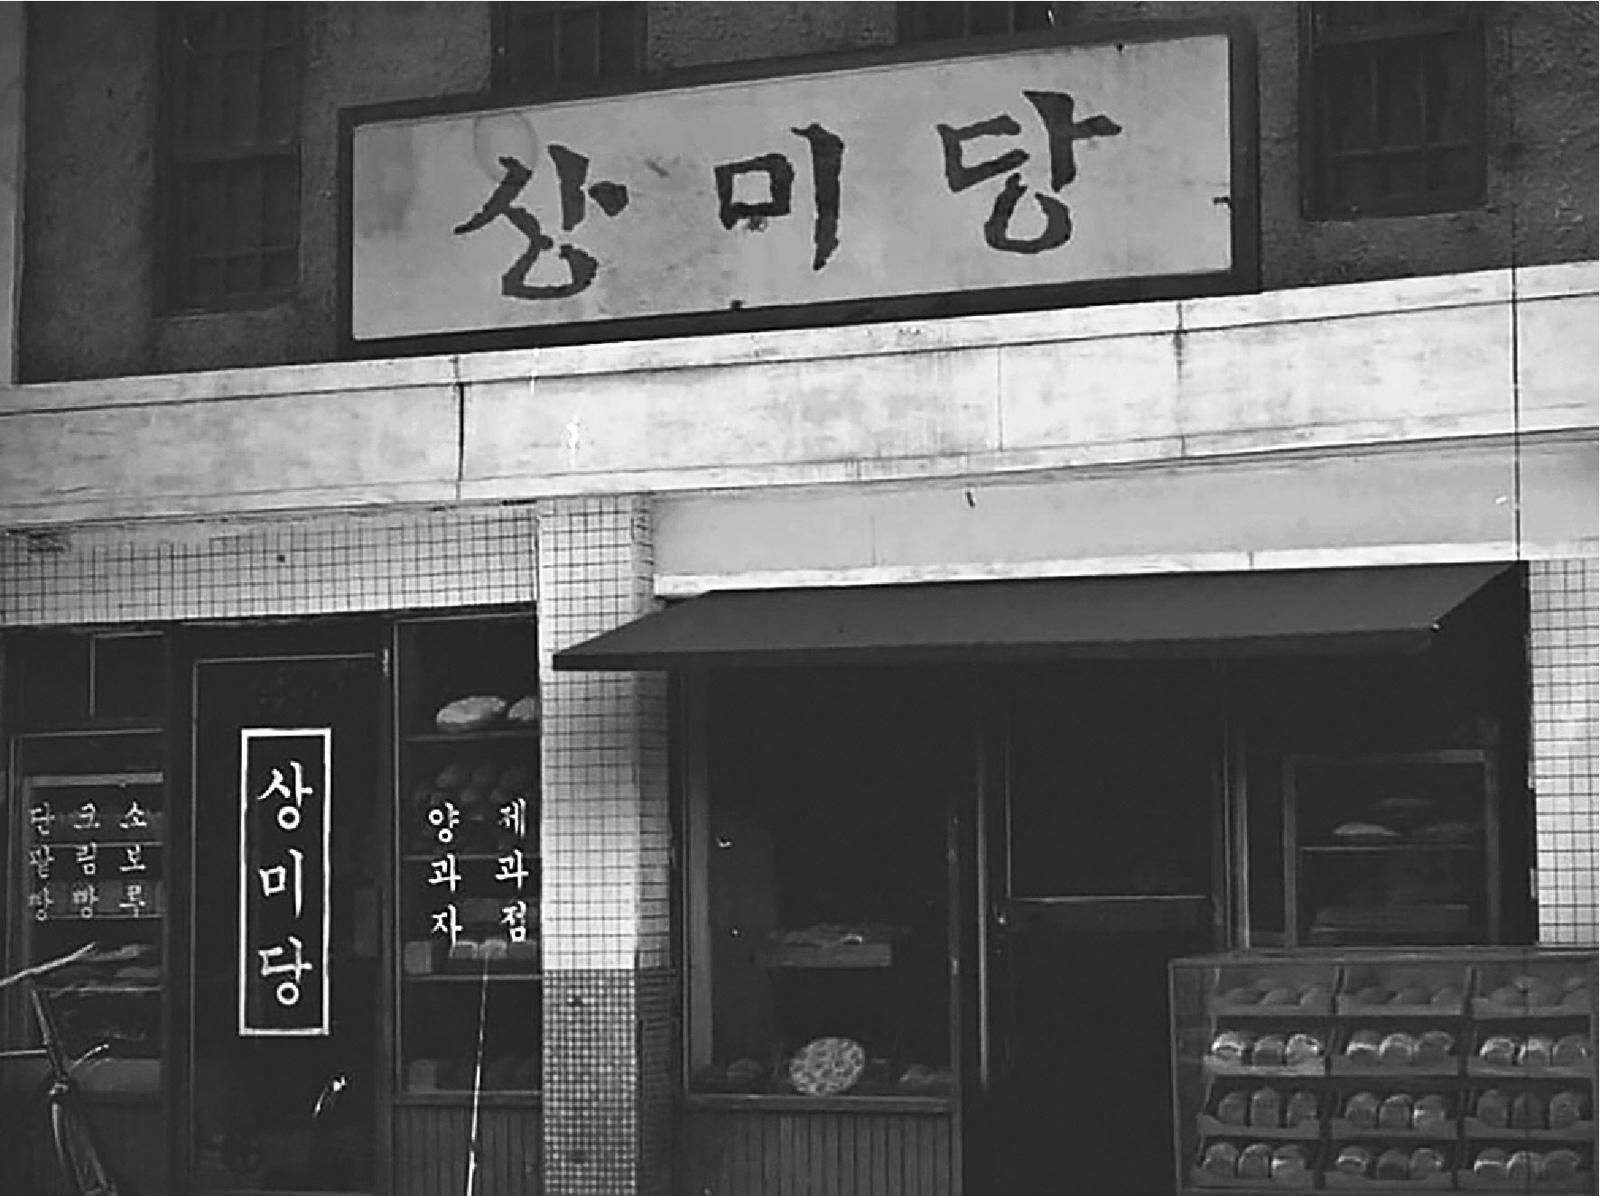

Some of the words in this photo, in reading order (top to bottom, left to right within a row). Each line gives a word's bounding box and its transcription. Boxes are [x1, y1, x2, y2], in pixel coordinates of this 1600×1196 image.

[454, 90, 1122, 300] 상미당
[257, 760, 313, 1006] 상미당
[428, 802, 463, 948] 양과자
[495, 798, 530, 943] 제과점
